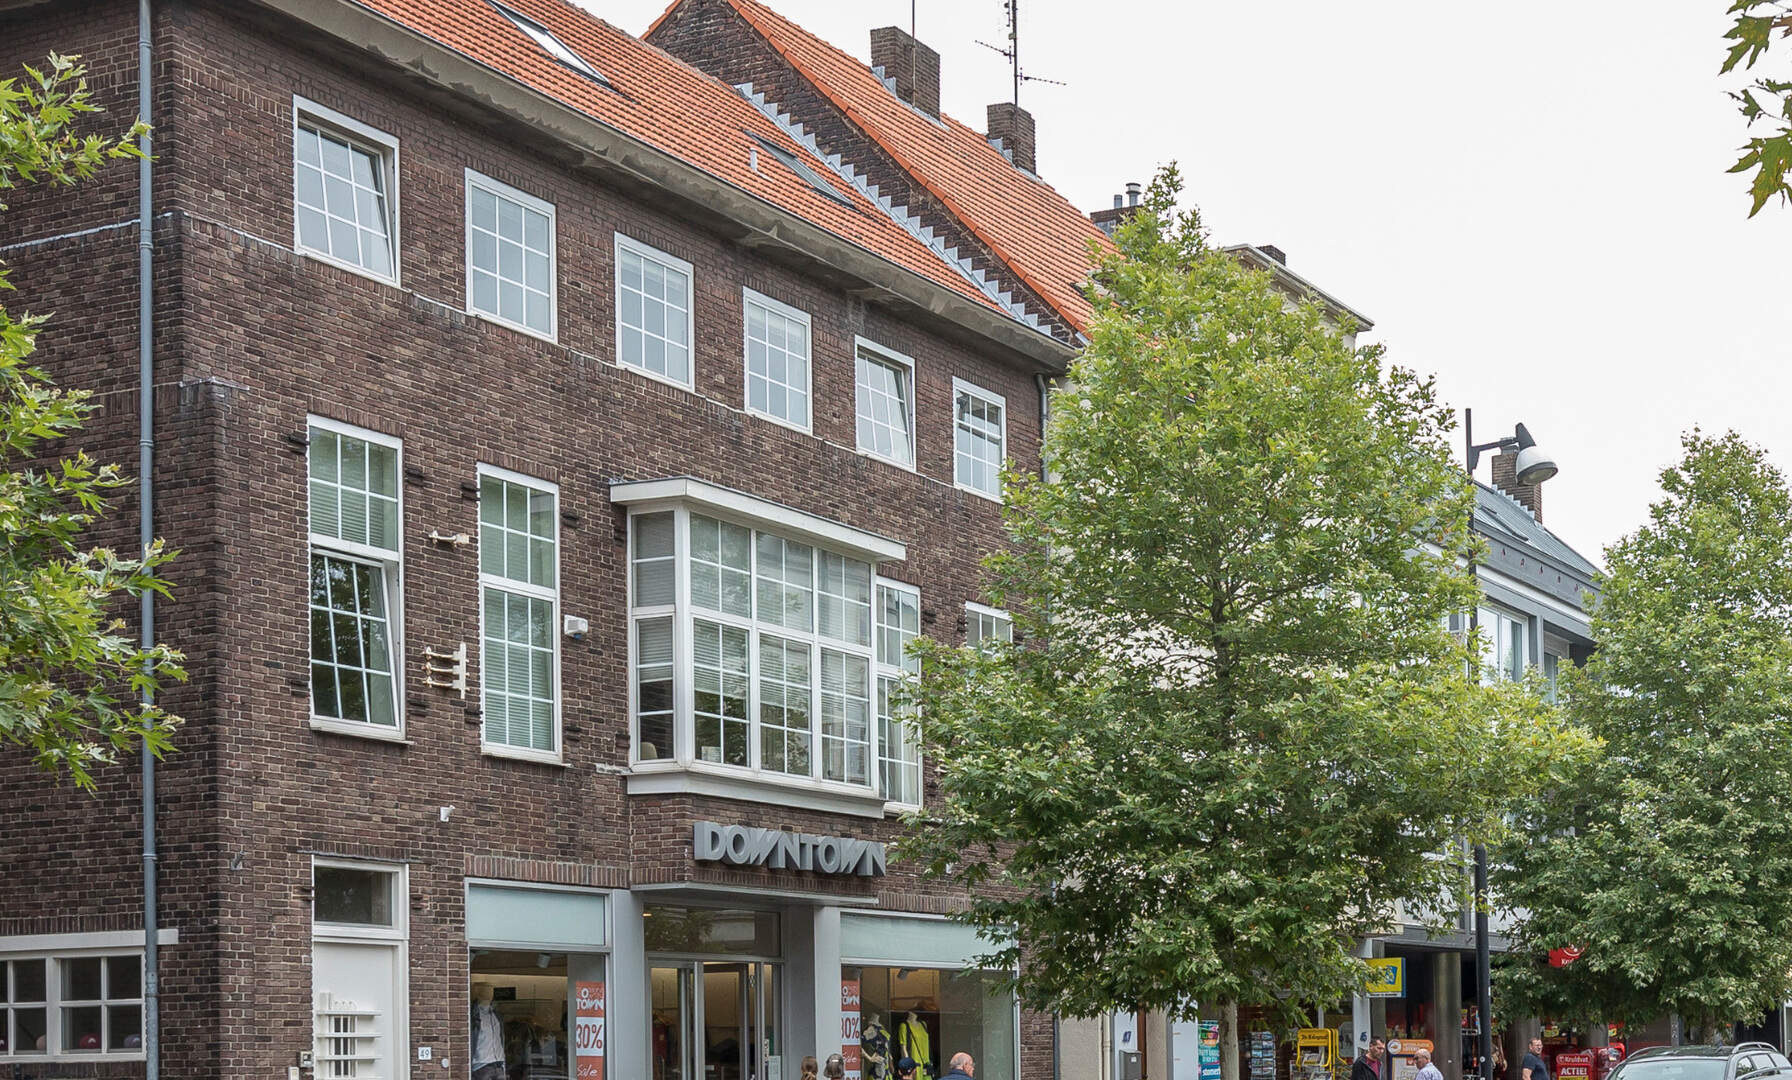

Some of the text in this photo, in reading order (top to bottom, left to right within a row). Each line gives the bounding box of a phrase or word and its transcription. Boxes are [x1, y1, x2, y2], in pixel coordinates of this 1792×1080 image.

[693, 820, 886, 876] DOWNTOWN
[576, 1023, 603, 1049] 30%
[419, 1048, 430, 1058] 49
[577, 1064, 599, 1077] Sale
[1561, 1067, 1588, 1076] ACTIE!
